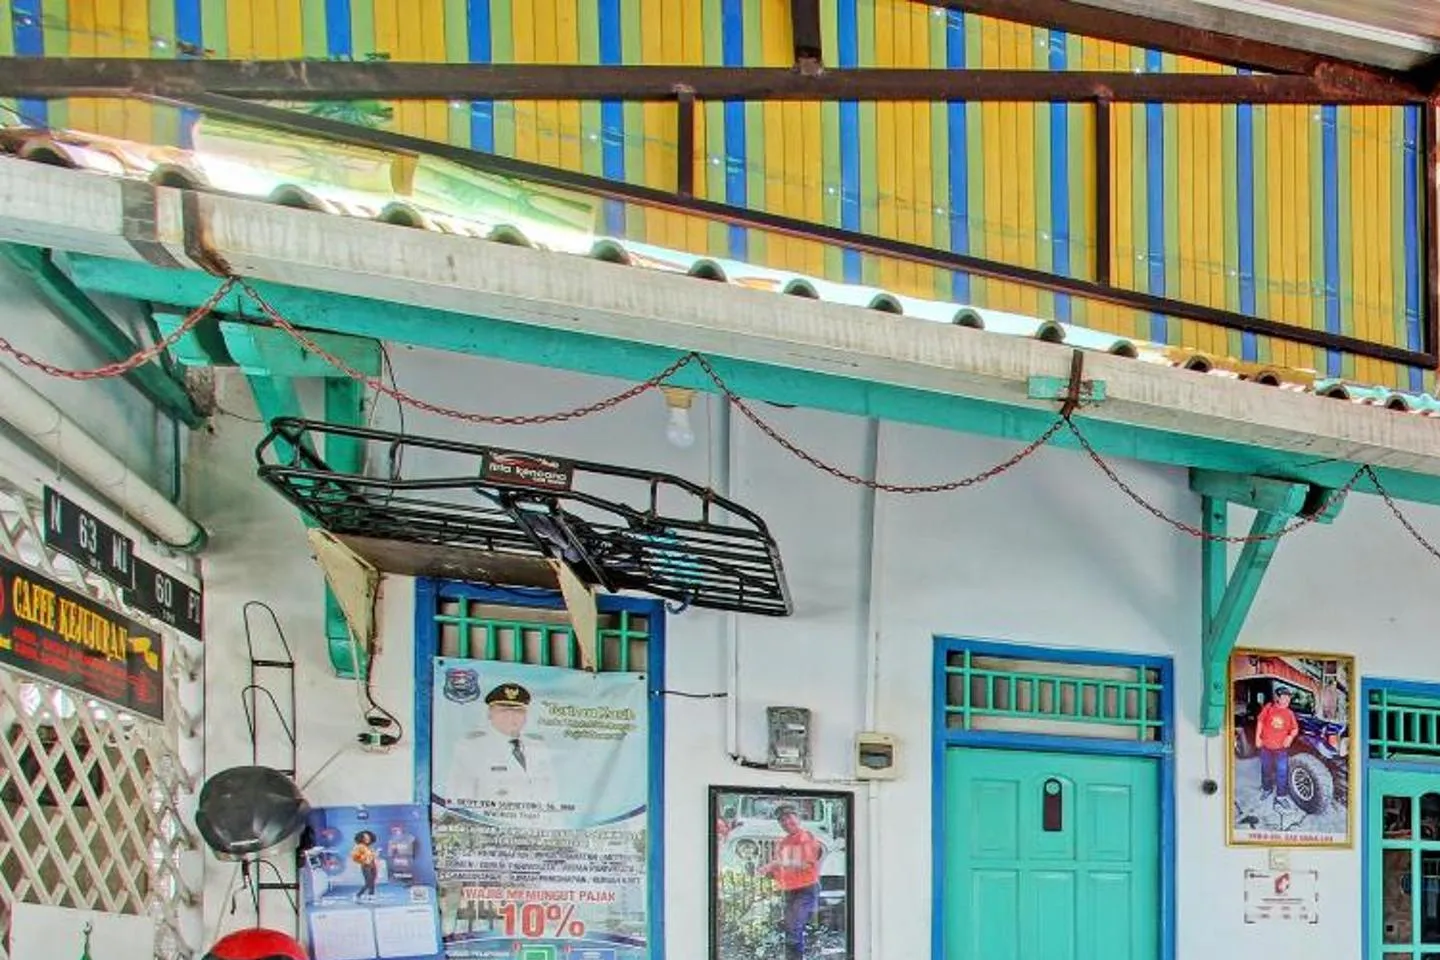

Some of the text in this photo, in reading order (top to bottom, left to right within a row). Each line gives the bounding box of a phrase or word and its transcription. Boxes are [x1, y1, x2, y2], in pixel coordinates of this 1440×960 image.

[79, 514, 97, 554] 63
[12, 576, 55, 630] CAFFE
[155, 573, 173, 608] 60
[579, 890, 616, 901] PAJAK
[503, 903, 585, 938] 10%
